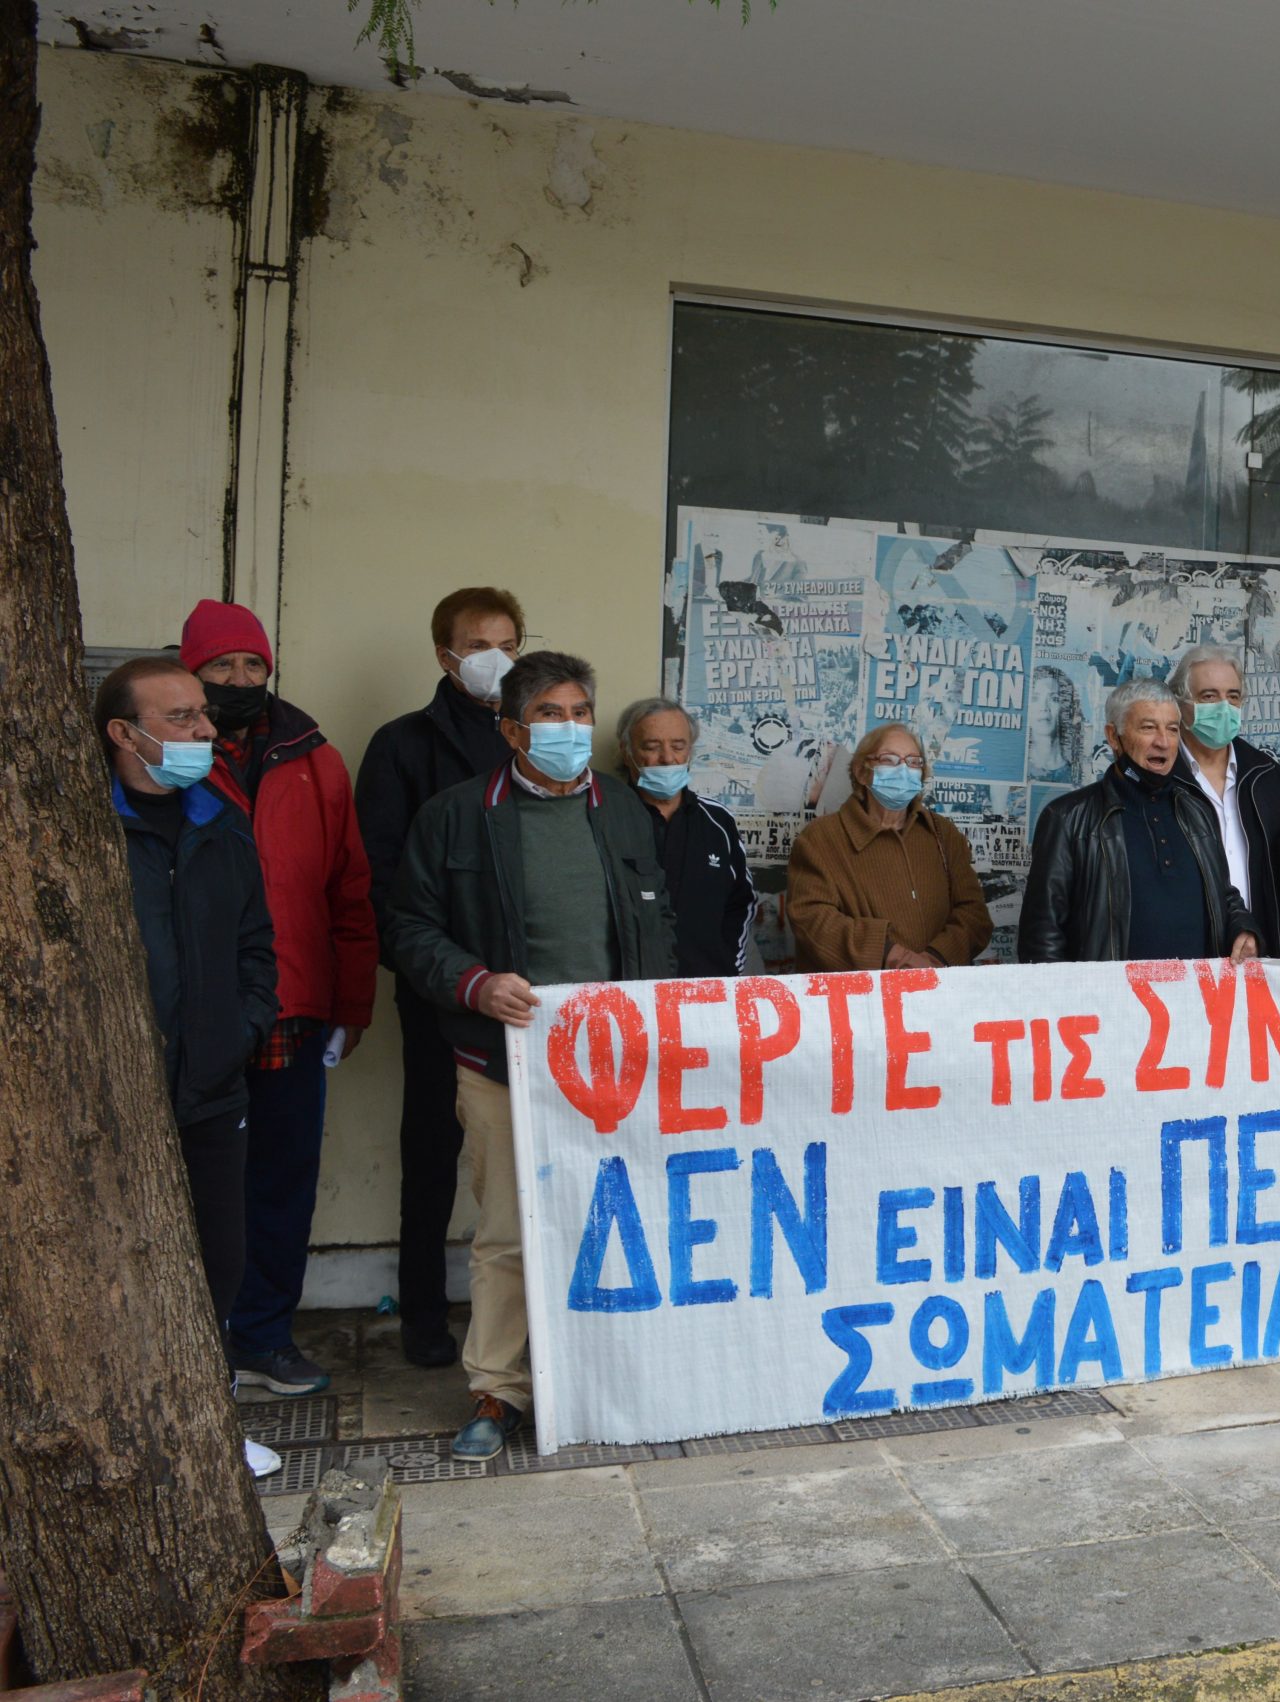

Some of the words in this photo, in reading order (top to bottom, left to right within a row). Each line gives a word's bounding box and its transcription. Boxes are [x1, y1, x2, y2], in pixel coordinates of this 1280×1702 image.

[784, 582, 834, 595] ΣΥΝΕΔΡΙΟ
[878, 633, 1023, 672] ΣΥΝΔΙΚΑΤΑ
[768, 828, 778, 846] 5
[547, 967, 941, 1134] ΦΕΡΤΕ
[973, 1014, 1105, 1105] ΤΙΣ
[567, 1140, 827, 1312] ΔΕΝ
[876, 1166, 1127, 1285] ΕΙΝΑΙ
